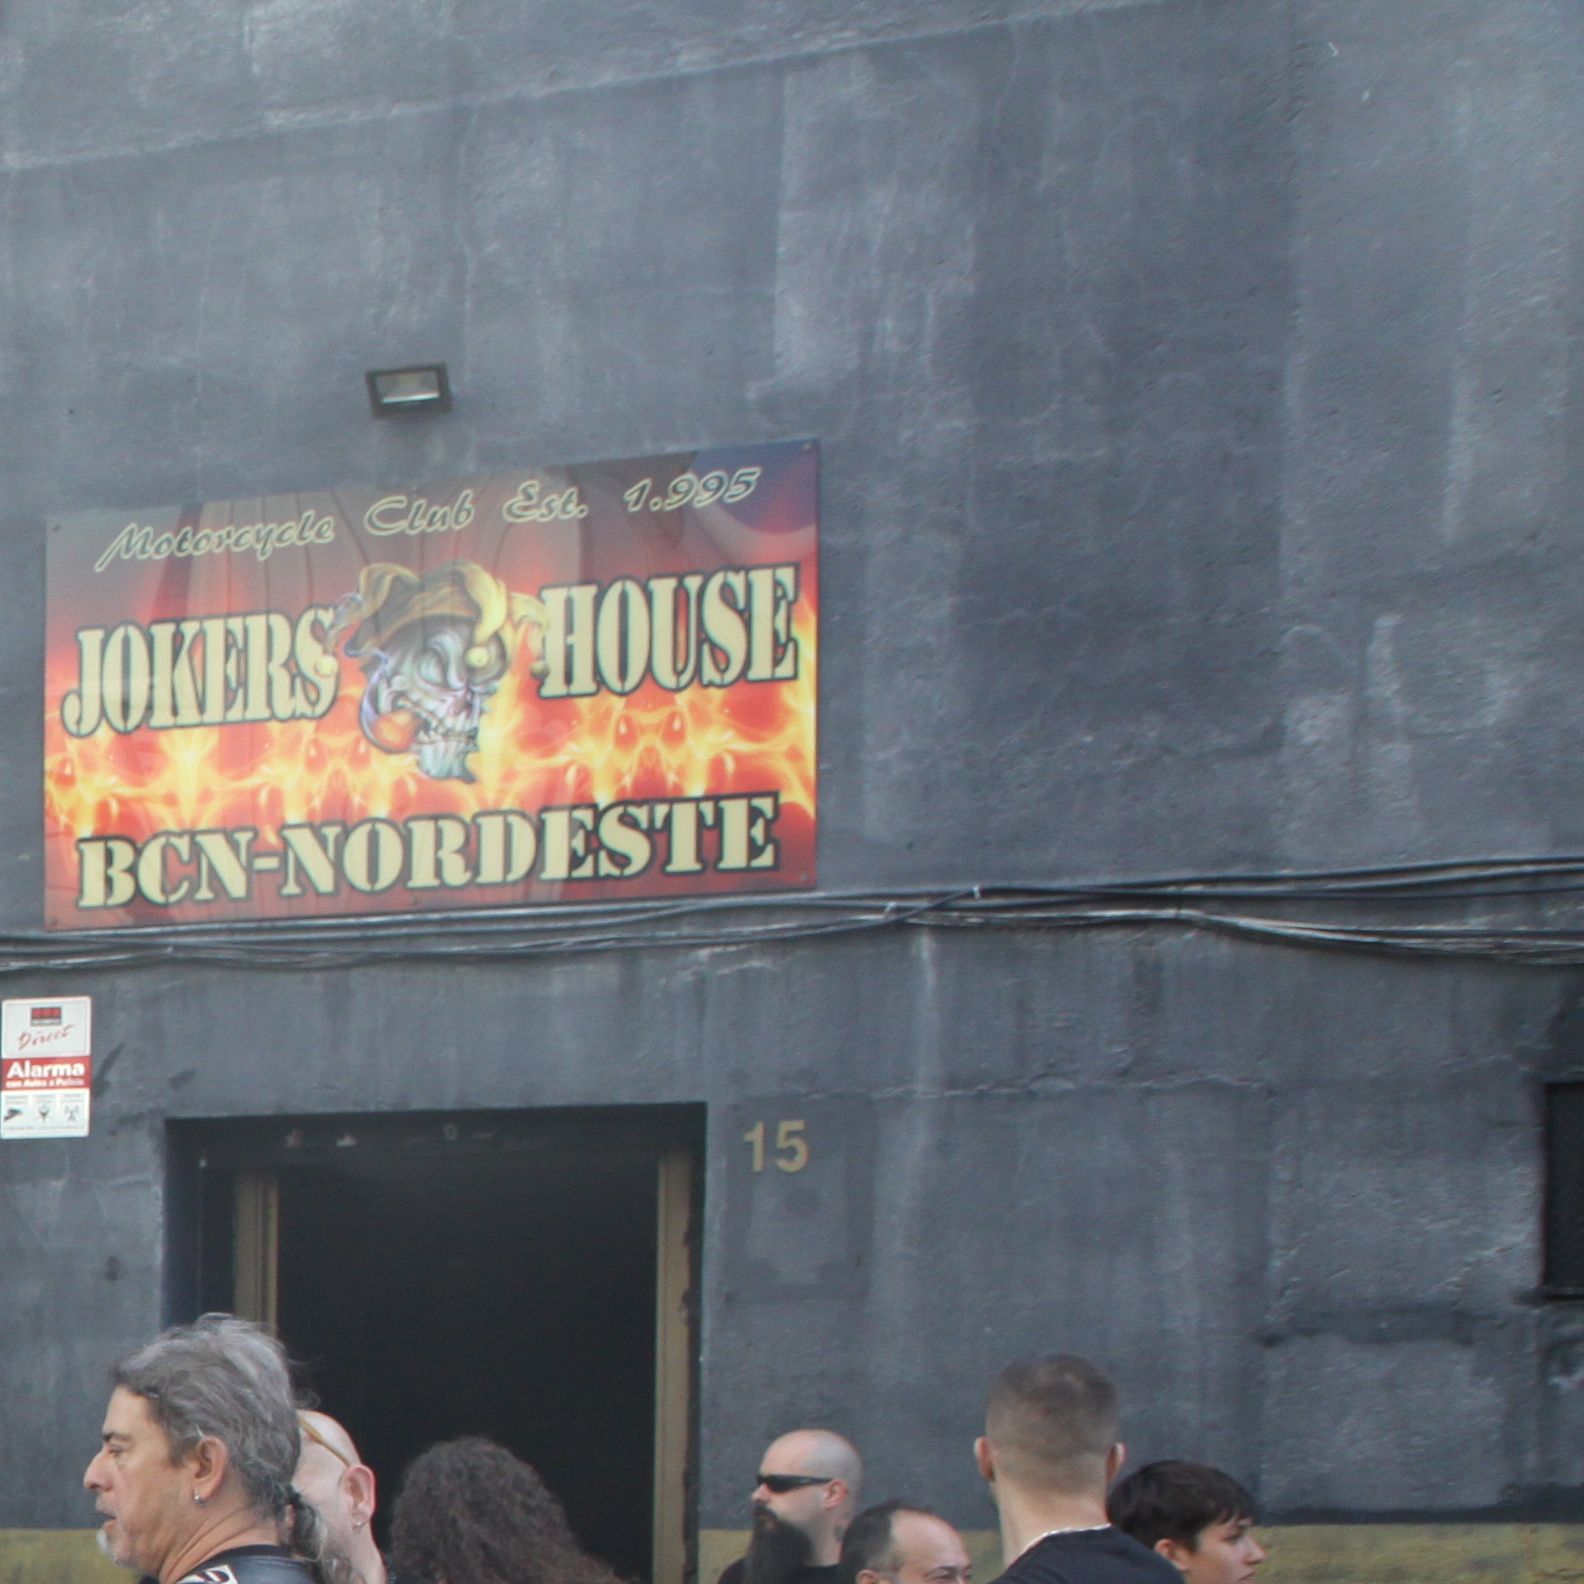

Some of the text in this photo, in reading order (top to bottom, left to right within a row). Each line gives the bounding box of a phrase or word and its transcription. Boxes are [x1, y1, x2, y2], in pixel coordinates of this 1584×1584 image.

[94, 466, 764, 572] Motorcycle Club Est. 1.995
[60, 563, 800, 738] JOKERS HOUSE
[74, 790, 780, 910] BCN-NORDESTE
[6, 1060, 85, 1079] Alarma
[743, 1119, 810, 1173] 15
